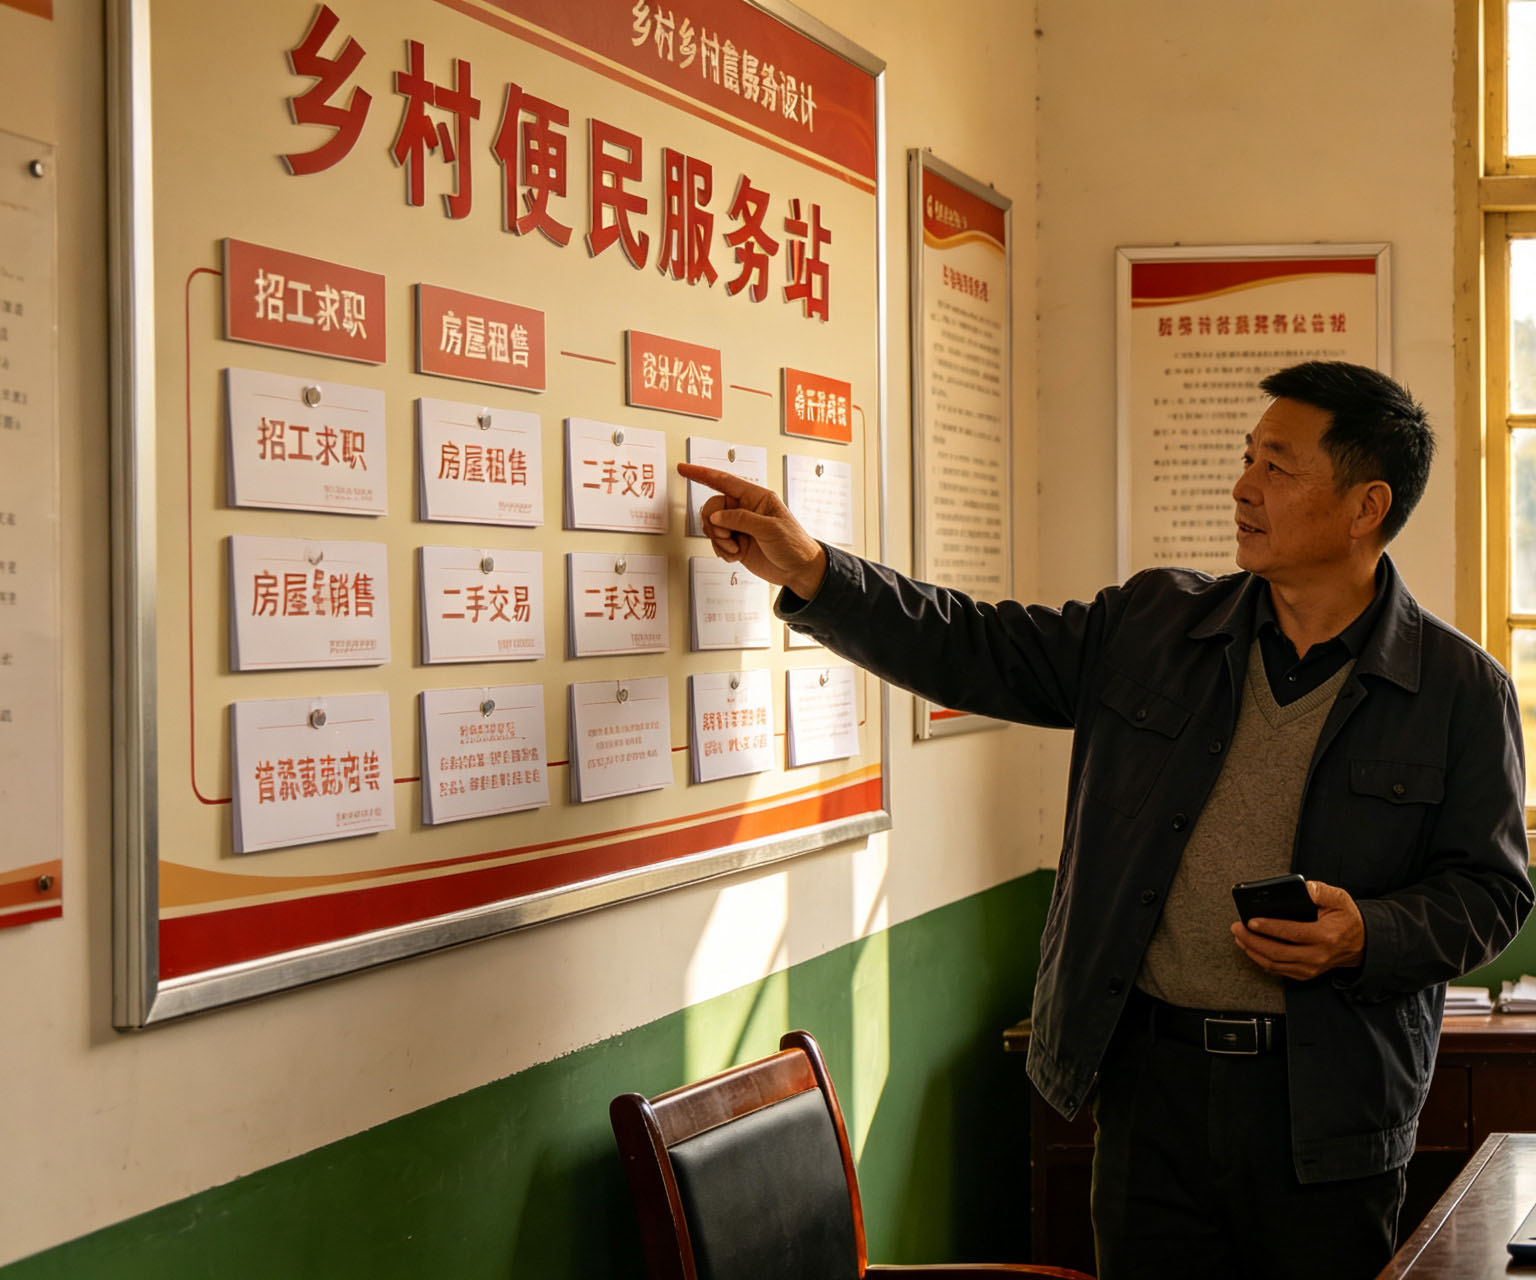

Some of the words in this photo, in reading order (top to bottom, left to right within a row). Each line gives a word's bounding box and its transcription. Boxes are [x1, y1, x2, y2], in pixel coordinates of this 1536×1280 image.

[281, 4, 832, 323] 乡村便民服务站
[254, 268, 368, 340] 招工求职
[439, 310, 530, 368] 房屋租售
[256, 416, 369, 472] 招工求职
[437, 440, 528, 486] 房屋租售
[582, 459, 655, 499] 二手交易
[441, 583, 531, 624] 二手交易
[584, 583, 657, 620] 二手交易
